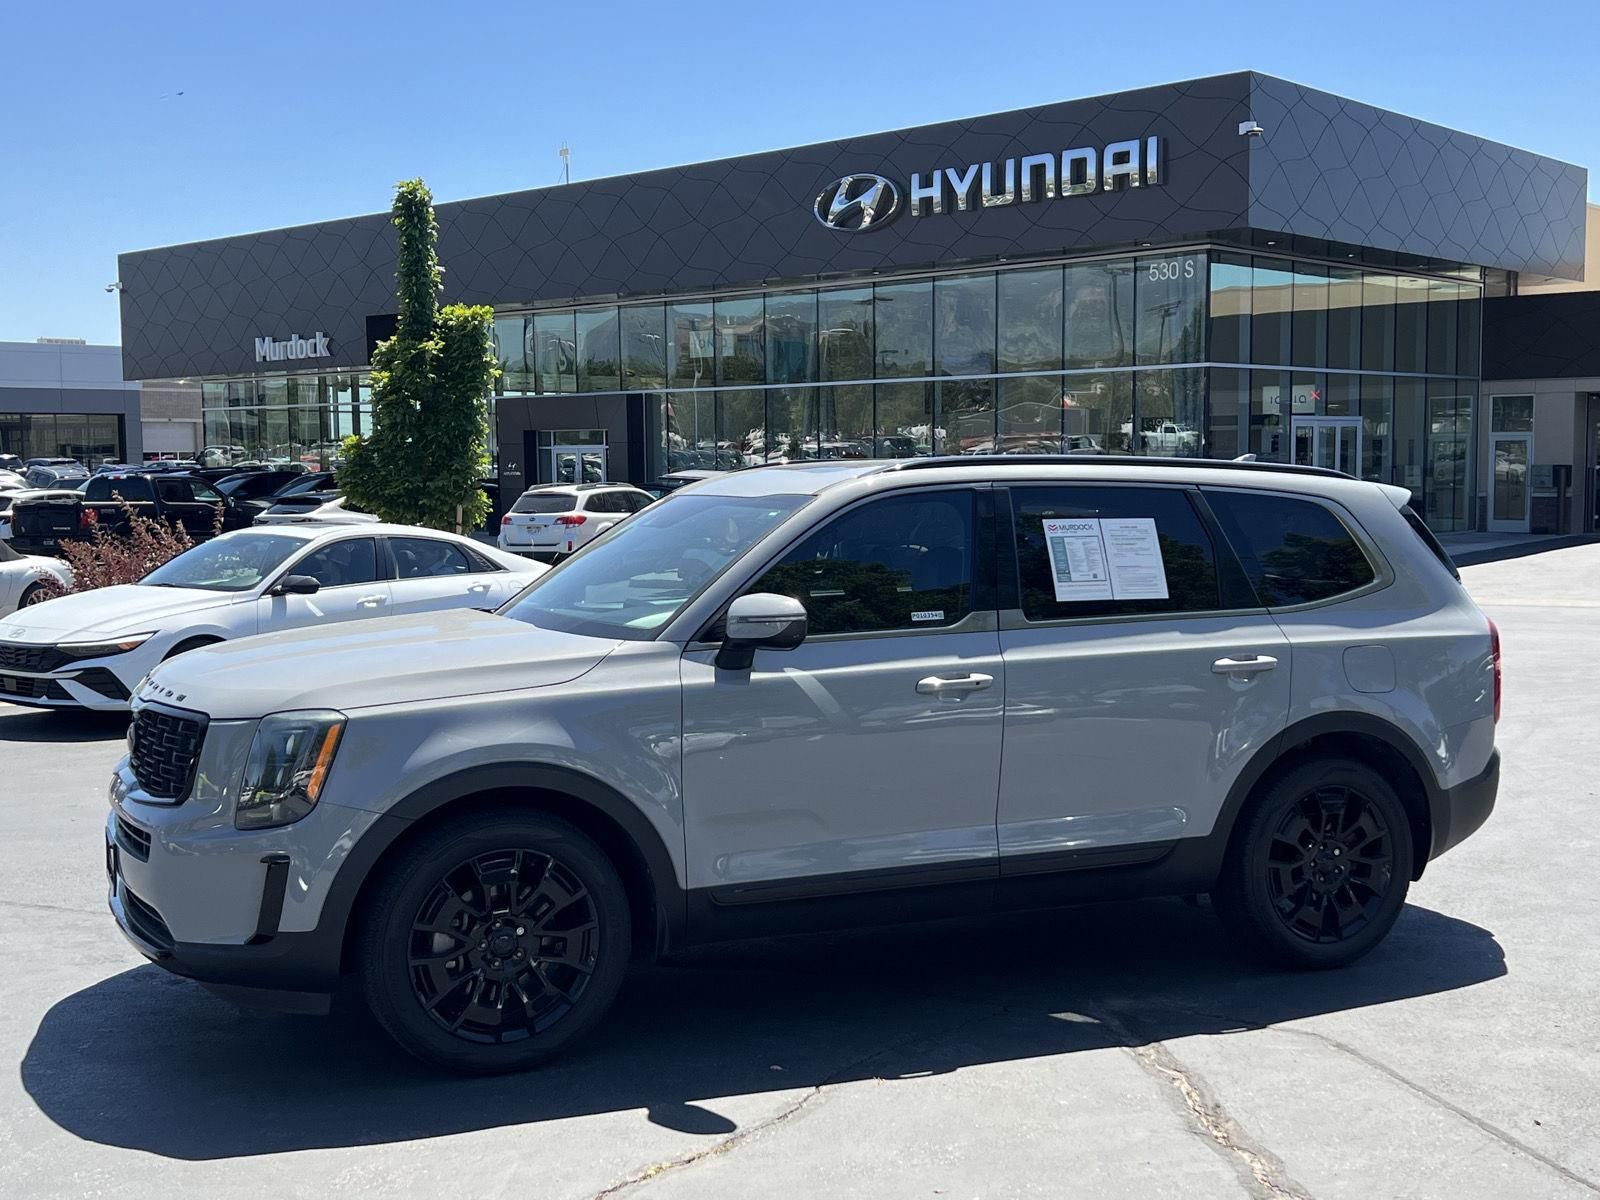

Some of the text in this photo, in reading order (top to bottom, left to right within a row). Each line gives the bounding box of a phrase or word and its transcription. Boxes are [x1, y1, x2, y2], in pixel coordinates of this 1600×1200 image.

[910, 135, 1160, 217] HYUNDAI
[1149, 260, 1194, 281] 530 S
[254, 331, 331, 362] Murdock
[1270, 394, 1307, 405] IOIQ
